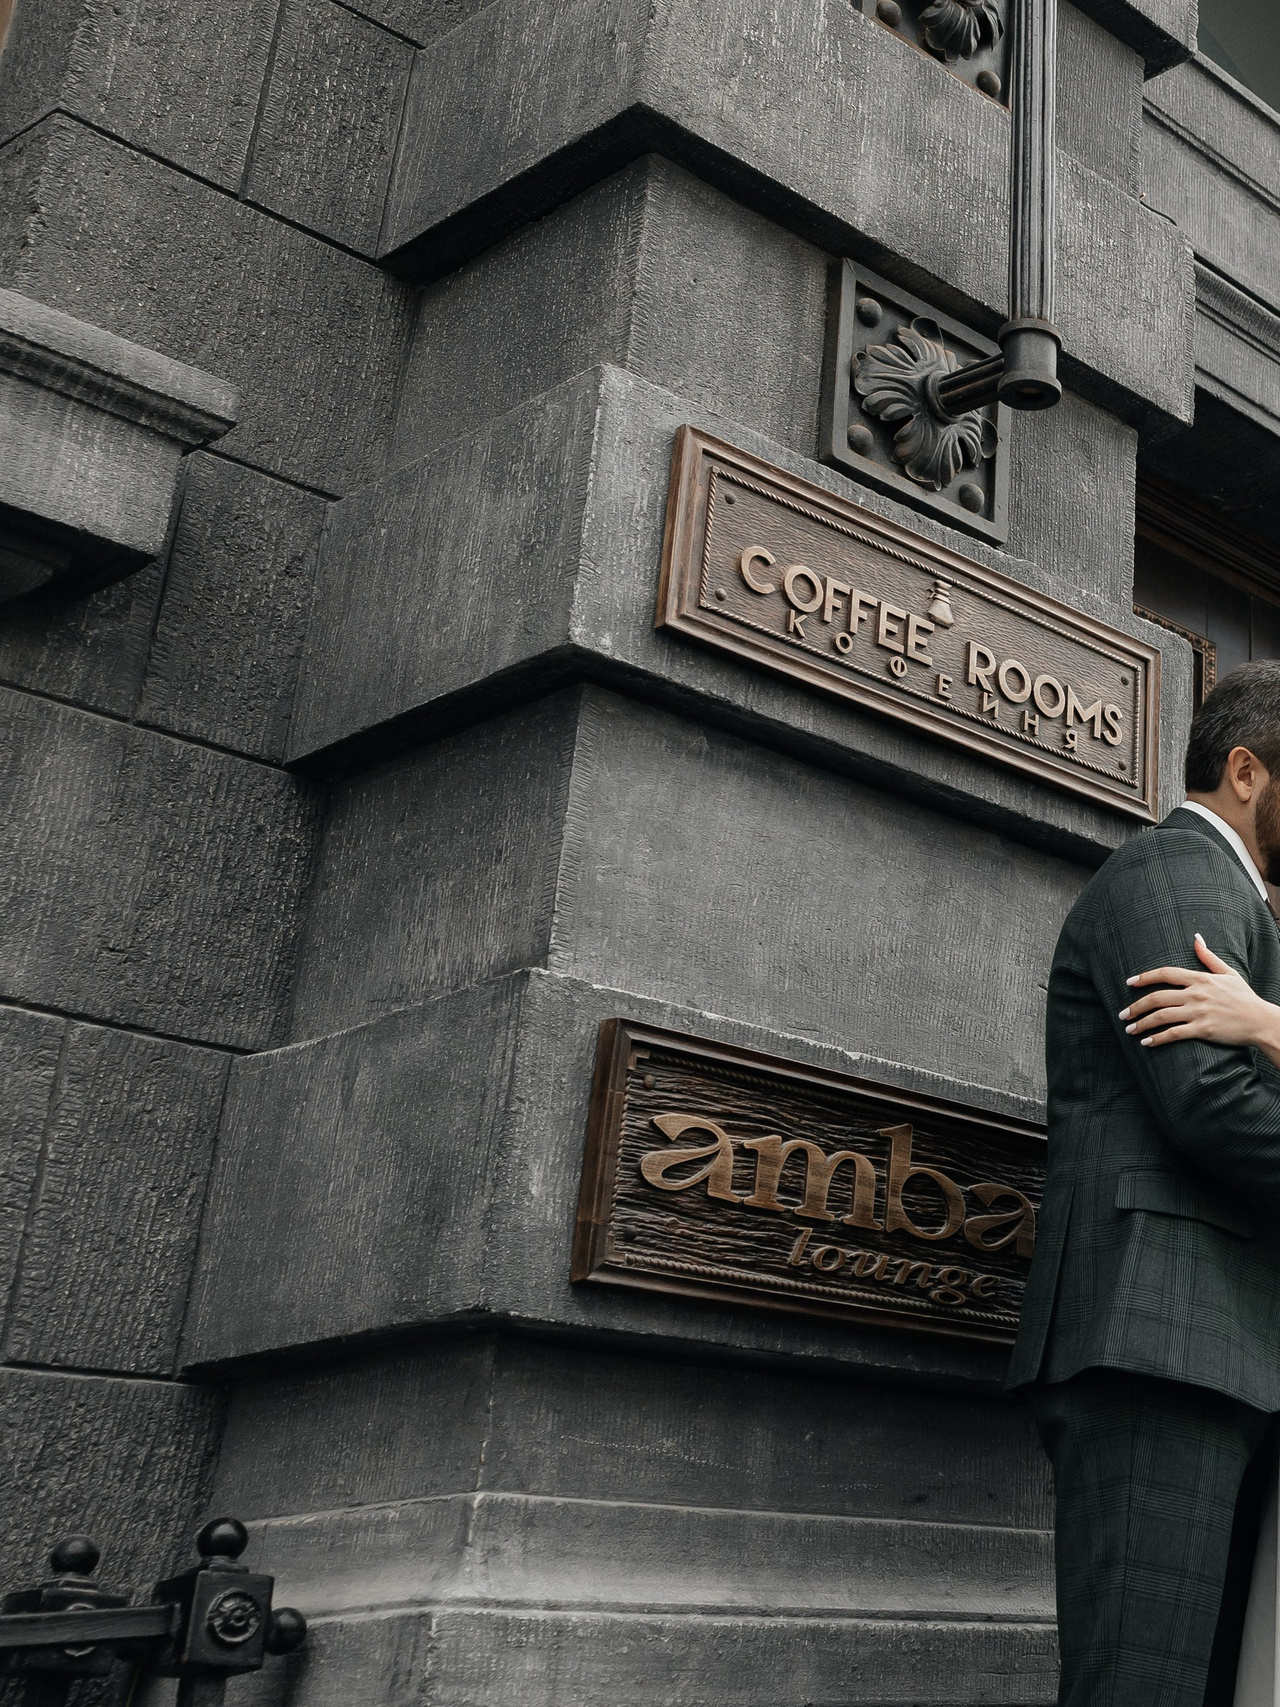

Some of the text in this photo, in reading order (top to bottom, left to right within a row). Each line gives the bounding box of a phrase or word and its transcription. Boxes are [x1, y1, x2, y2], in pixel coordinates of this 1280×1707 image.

[740, 545, 1123, 747] COFFEE ROOMS
[787, 1226, 1003, 1305] lounge
